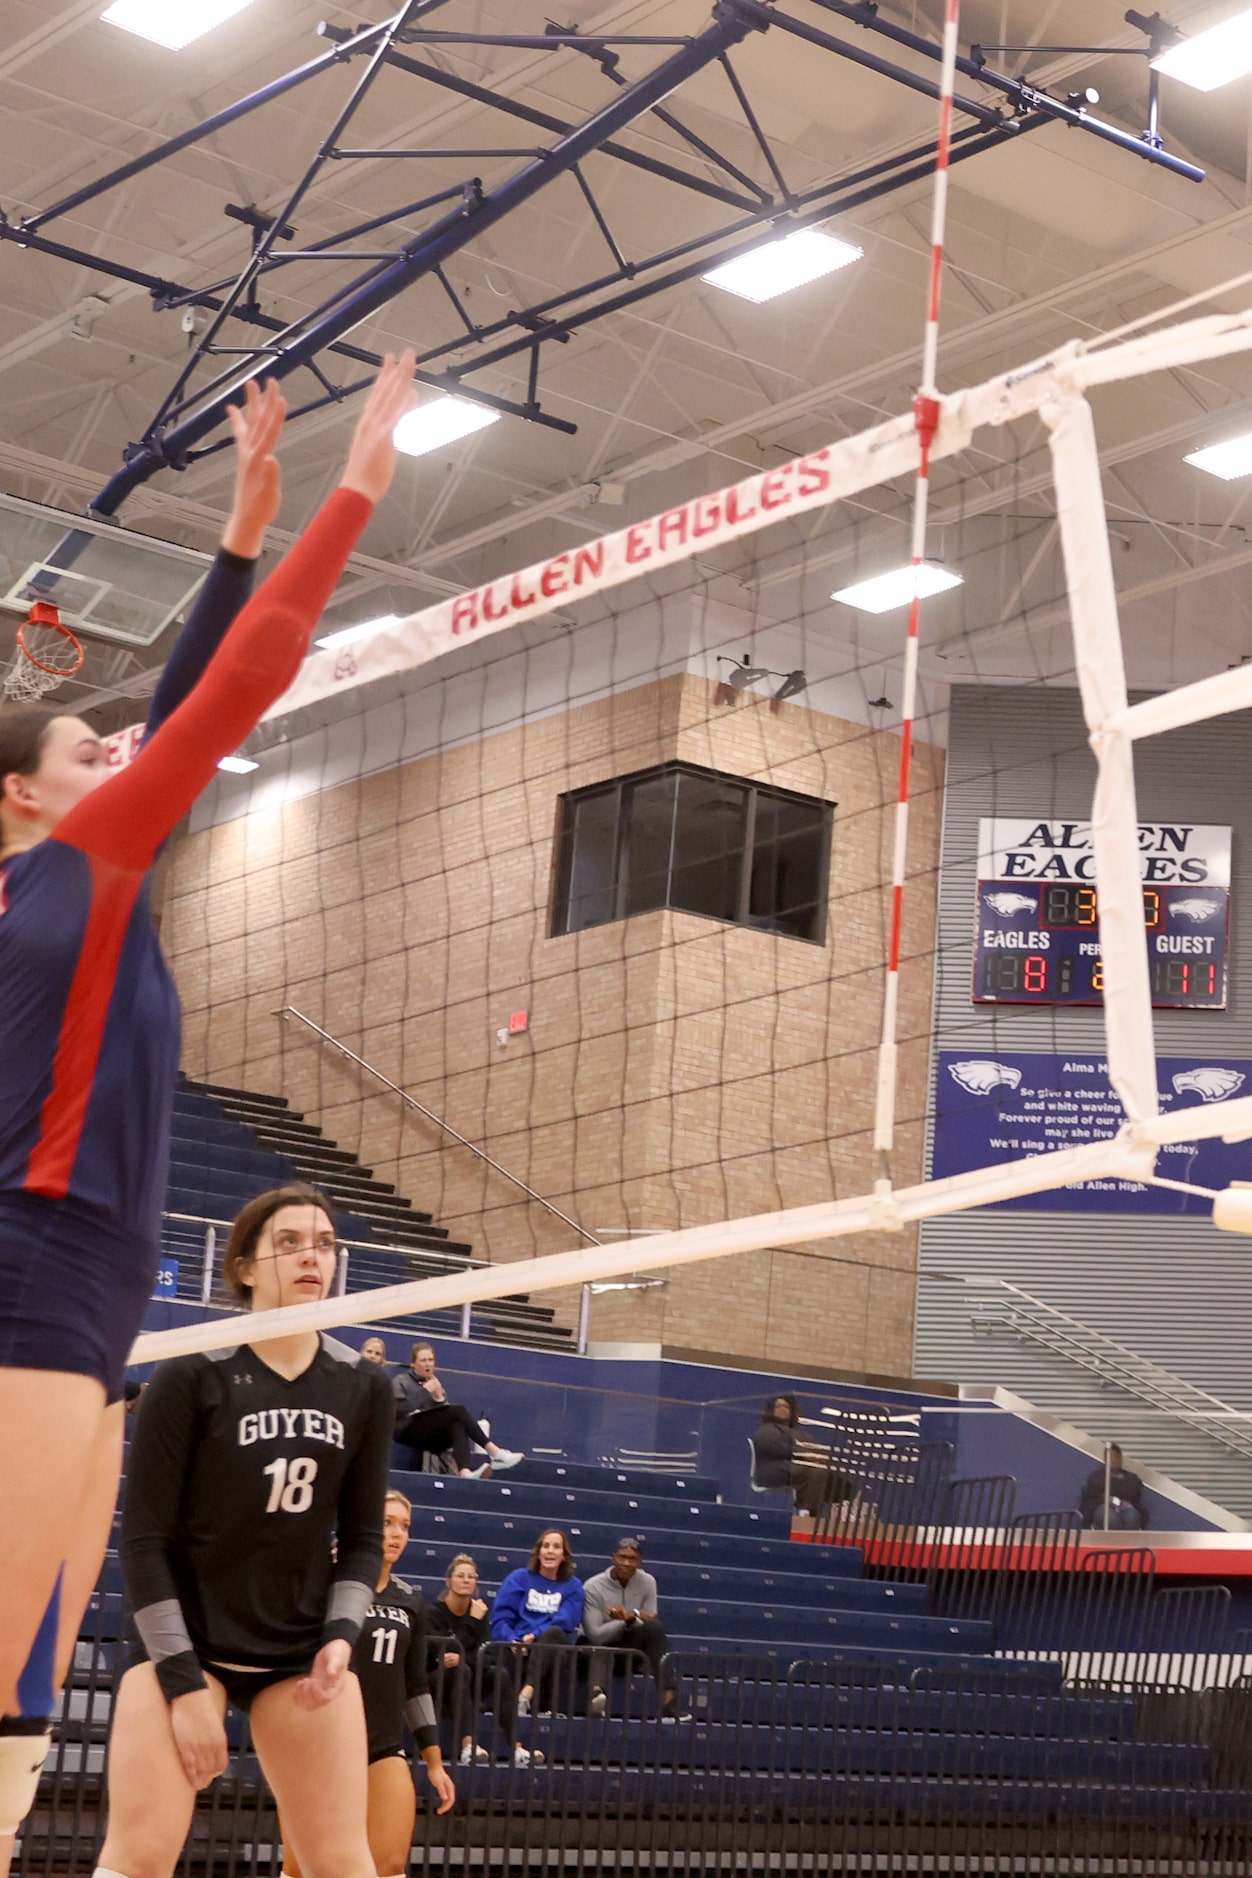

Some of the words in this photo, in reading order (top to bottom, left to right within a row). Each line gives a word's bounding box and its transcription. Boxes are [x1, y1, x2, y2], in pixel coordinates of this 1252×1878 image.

[452, 541, 605, 636] ALLEN
[624, 449, 832, 565] EAGLES
[1018, 823, 1193, 852] ALEN
[1001, 853, 1209, 883] EAGES
[984, 930, 1050, 950] EAGLES
[1079, 943, 1102, 956] PER
[1156, 935, 1215, 955] GUEST
[1023, 956, 1048, 993] 8
[1181, 964, 1216, 995] 11
[1062, 1063, 1094, 1073] Alma
[1020, 1088, 1035, 1097] So
[1037, 1088, 1062, 1099] give
[1064, 1090, 1072, 1098] a
[1074, 1090, 1106, 1099] cheer
[1108, 1090, 1121, 1099] fo
[1024, 1101, 1045, 1110] and
[1047, 1101, 1079, 1111] white
[1081, 1102, 1121, 1114] waving
[999, 1113, 1042, 1123] Forever
[1044, 1115, 1079, 1125] proud
[1081, 1115, 1094, 1124] of
[1095, 1116, 1115, 1125] our
[1045, 1128, 1069, 1139] may
[1071, 1128, 1091, 1138] she
[1093, 1129, 1114, 1138] live
[989, 1139, 1019, 1148] We'll
[1021, 1140, 1045, 1150] sing
[1163, 1144, 1199, 1155] today,
[1087, 1182, 1116, 1191] Allen
[1119, 1182, 1148, 1193] High.
[238, 1408, 345, 1450] GUYER
[263, 1457, 318, 1514] 18
[365, 1604, 410, 1629] UYER
[371, 1627, 398, 1665] 11
